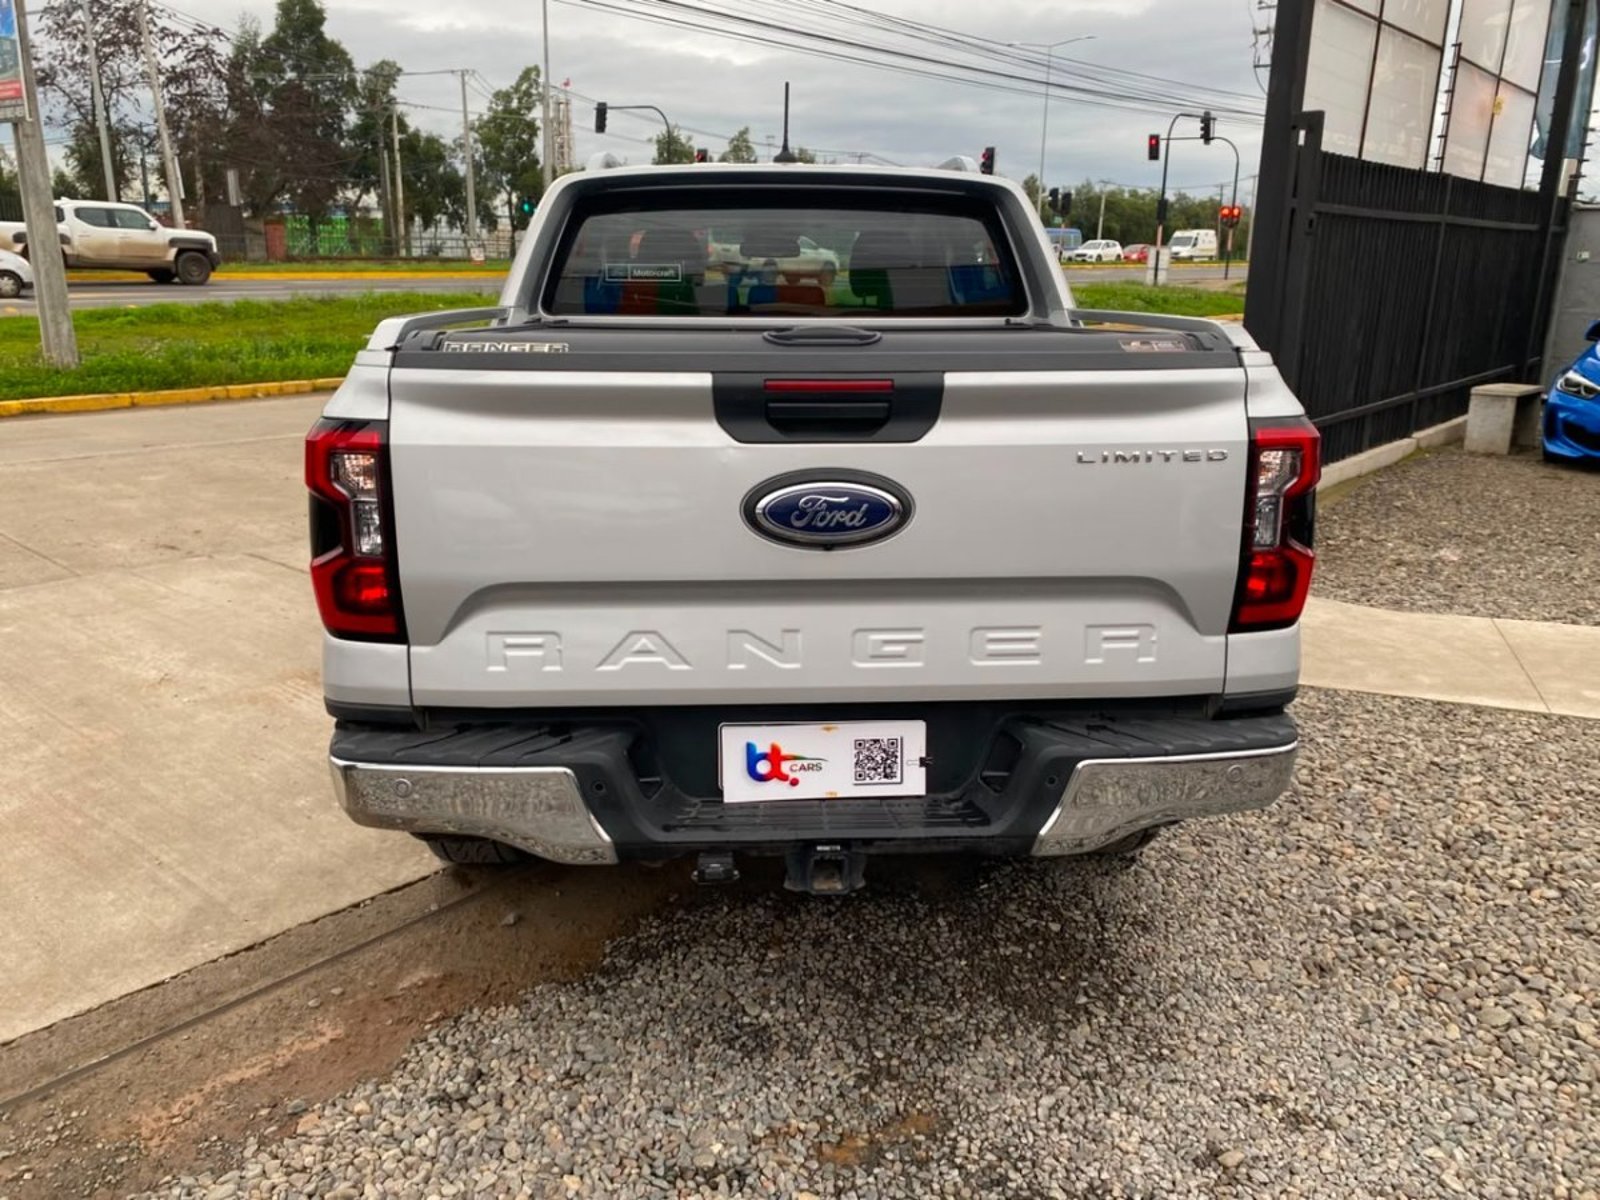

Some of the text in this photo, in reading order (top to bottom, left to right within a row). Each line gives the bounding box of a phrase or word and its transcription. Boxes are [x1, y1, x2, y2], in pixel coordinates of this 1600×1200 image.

[632, 268, 676, 278] Motorcraft
[443, 341, 569, 353] RANGER
[1076, 449, 1229, 464] LIMITED
[790, 495, 869, 527] Ford
[485, 624, 1159, 672] RANGER
[789, 762, 823, 773] CARS
